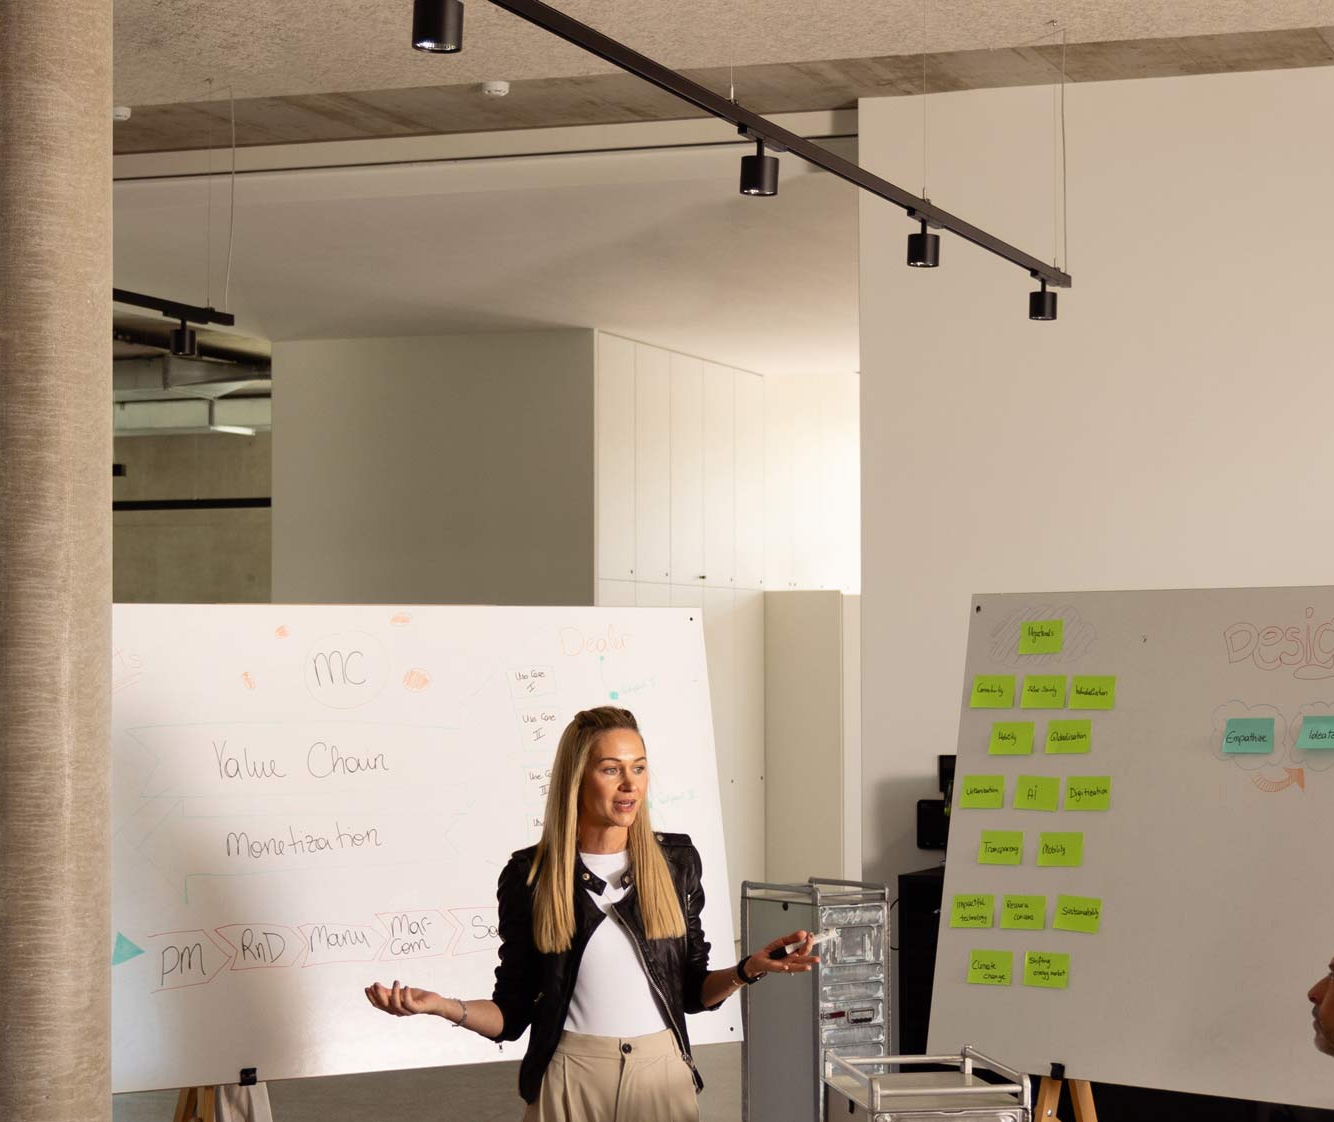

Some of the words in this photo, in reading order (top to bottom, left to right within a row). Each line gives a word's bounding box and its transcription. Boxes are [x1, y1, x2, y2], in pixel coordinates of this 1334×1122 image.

[313, 649, 367, 687] MC
[212, 740, 287, 780] Value
[306, 741, 389, 779] Chain
[225, 821, 383, 859] Monetization
[241, 928, 286, 963] RnD
